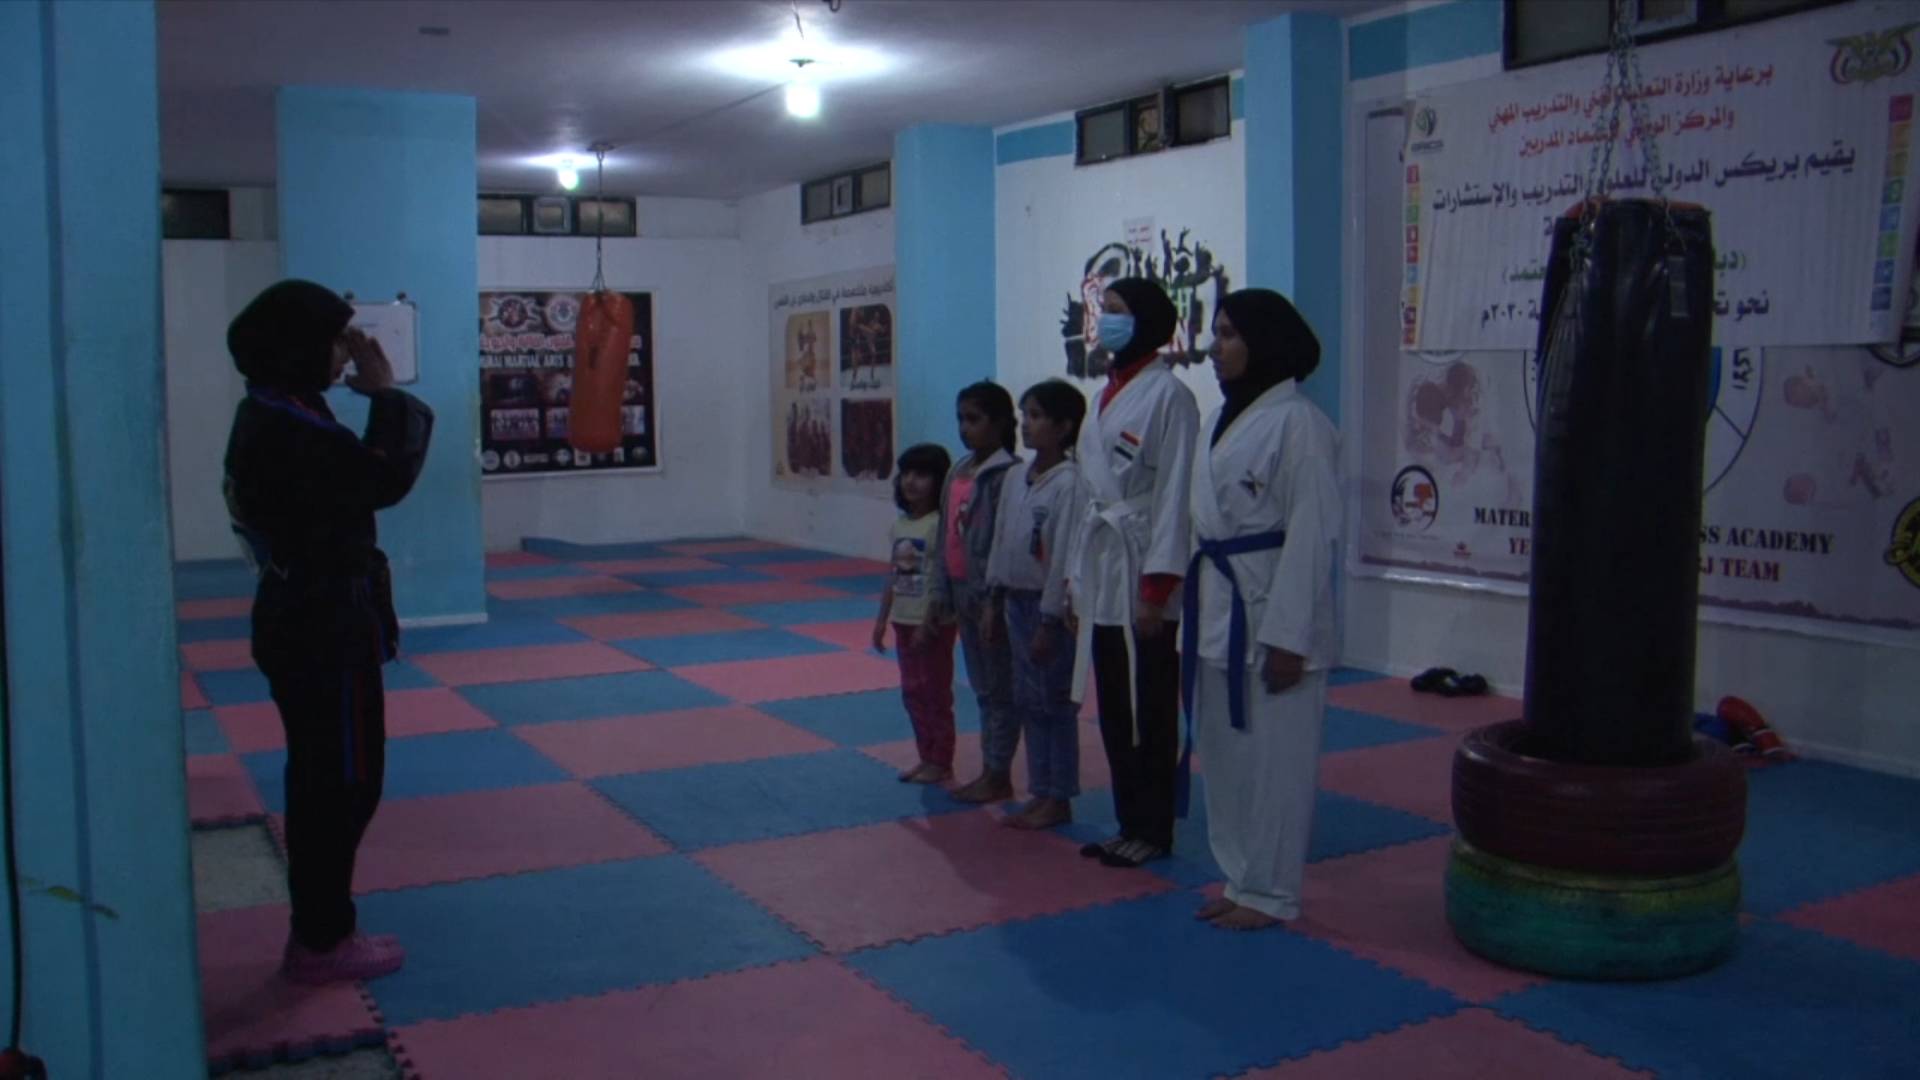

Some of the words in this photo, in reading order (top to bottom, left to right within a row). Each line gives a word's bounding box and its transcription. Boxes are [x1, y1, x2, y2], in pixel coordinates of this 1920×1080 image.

[1675, 70, 1710, 97] وزارة
[1715, 64, 1773, 92] برعاية
[1522, 93, 1580, 123] والتدريب
[1673, 105, 1734, 135] والمركز
[1715, 152, 1799, 187] بريكس
[1805, 140, 1856, 178] يقيم
[1735, 289, 1770, 322] نحو
[1473, 506, 1532, 528] MATER
[1726, 526, 1835, 555] ACADEMY
[1720, 557, 1781, 582] TEAM
